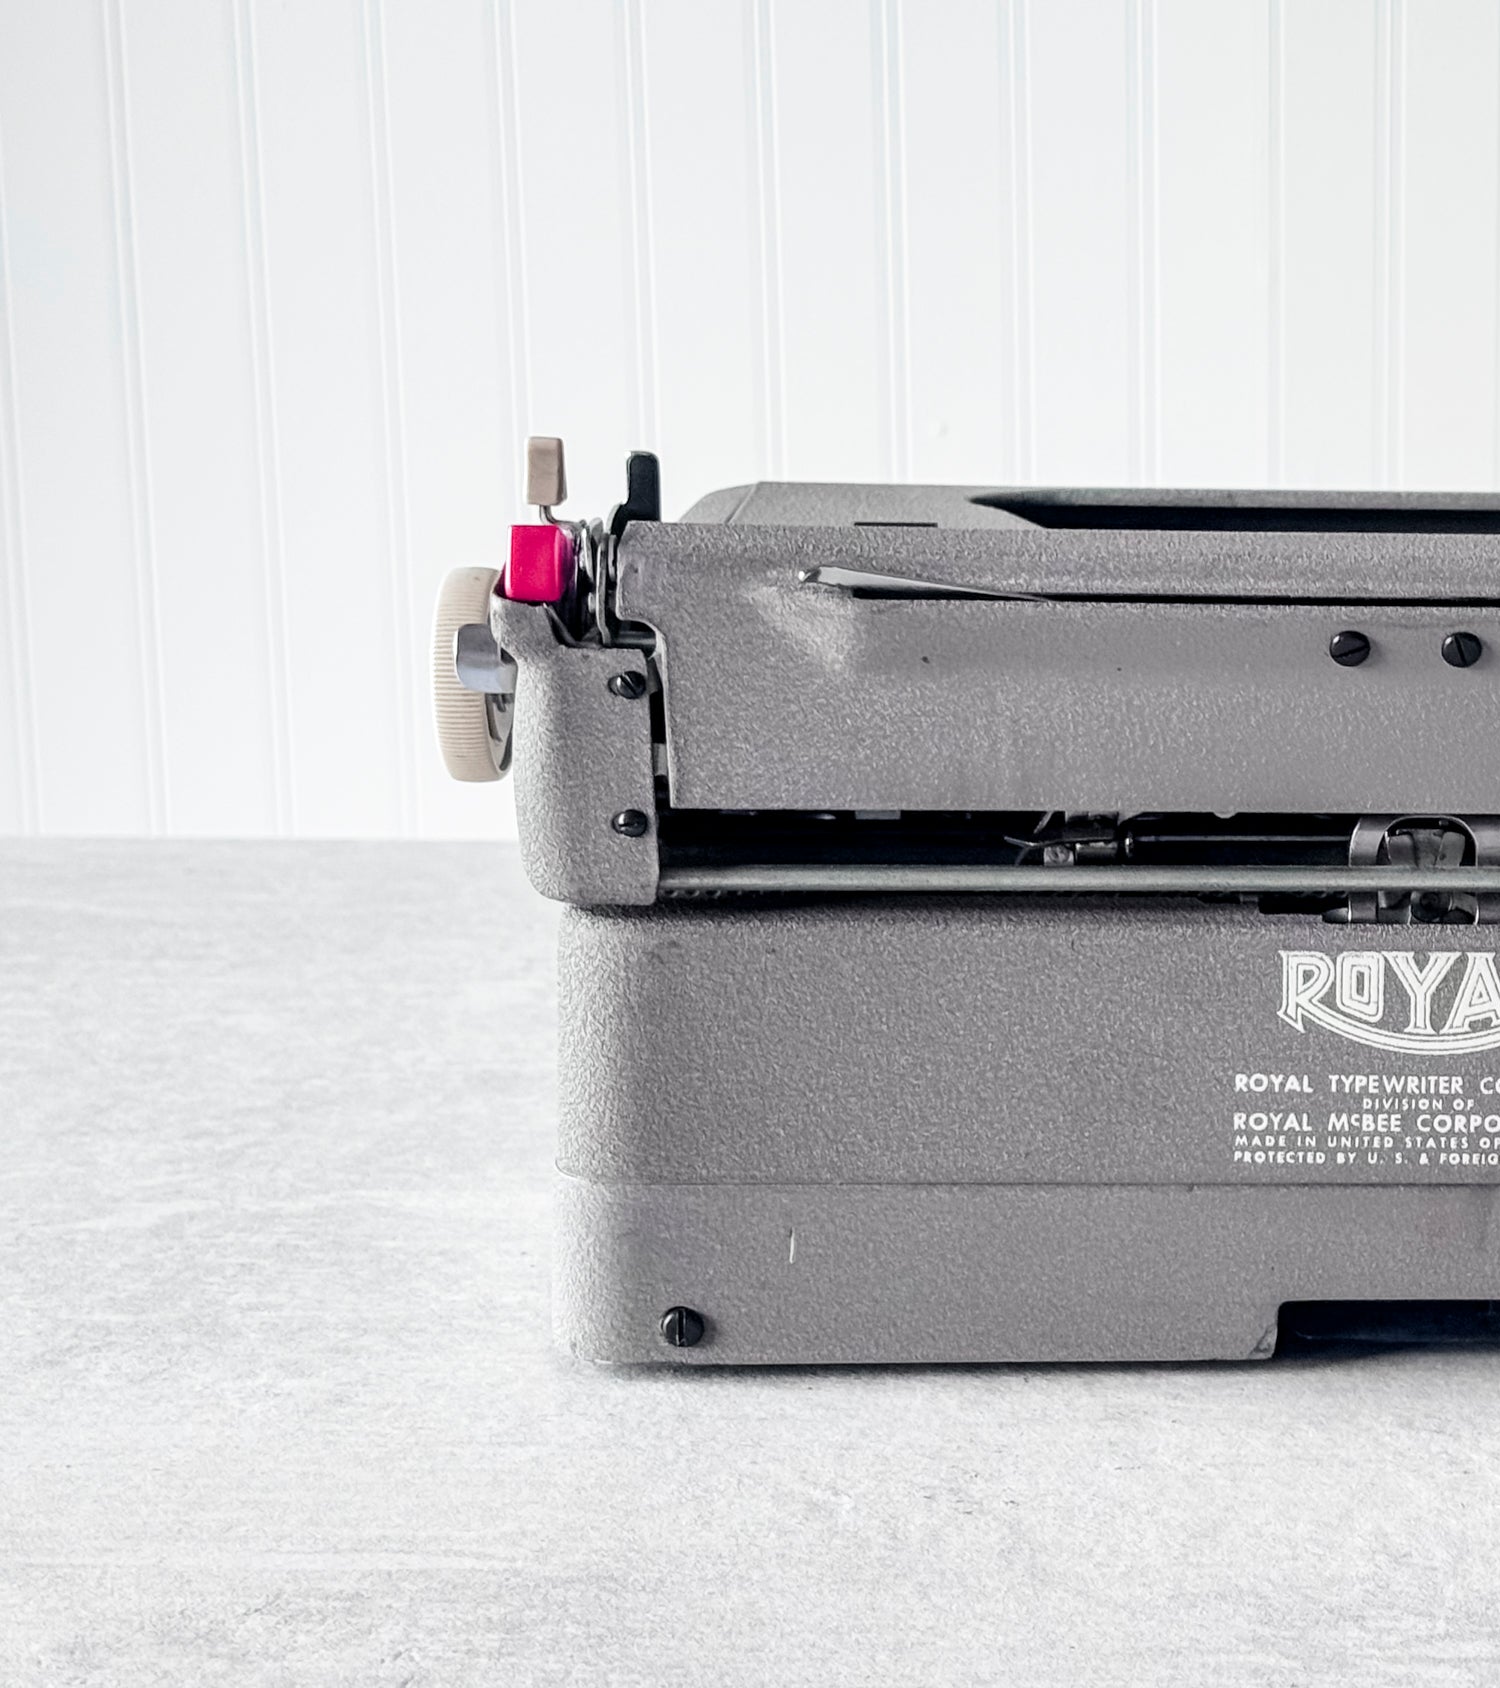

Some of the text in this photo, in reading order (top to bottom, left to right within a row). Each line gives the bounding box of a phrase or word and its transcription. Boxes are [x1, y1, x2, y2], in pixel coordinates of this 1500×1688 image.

[1235, 1074, 1313, 1093] ROYAL
[1329, 1075, 1463, 1095] TYPEWRITER
[1363, 1099, 1474, 1110] DIVISION OF
[1233, 1112, 1312, 1132] ROYAL
[1328, 1113, 1401, 1132] McBEE
[1235, 1136, 1286, 1148] MADE
[1298, 1136, 1316, 1148] IN
[1328, 1137, 1393, 1148] UNITED
[1406, 1137, 1468, 1149] STATES
[1479, 1137, 1500, 1149] OF
[1234, 1151, 1325, 1164] PROTECTED
[1337, 1152, 1355, 1164] BY
[1367, 1152, 1385, 1165] U.
[1395, 1153, 1408, 1165] S.
[1419, 1153, 1428, 1165] &
